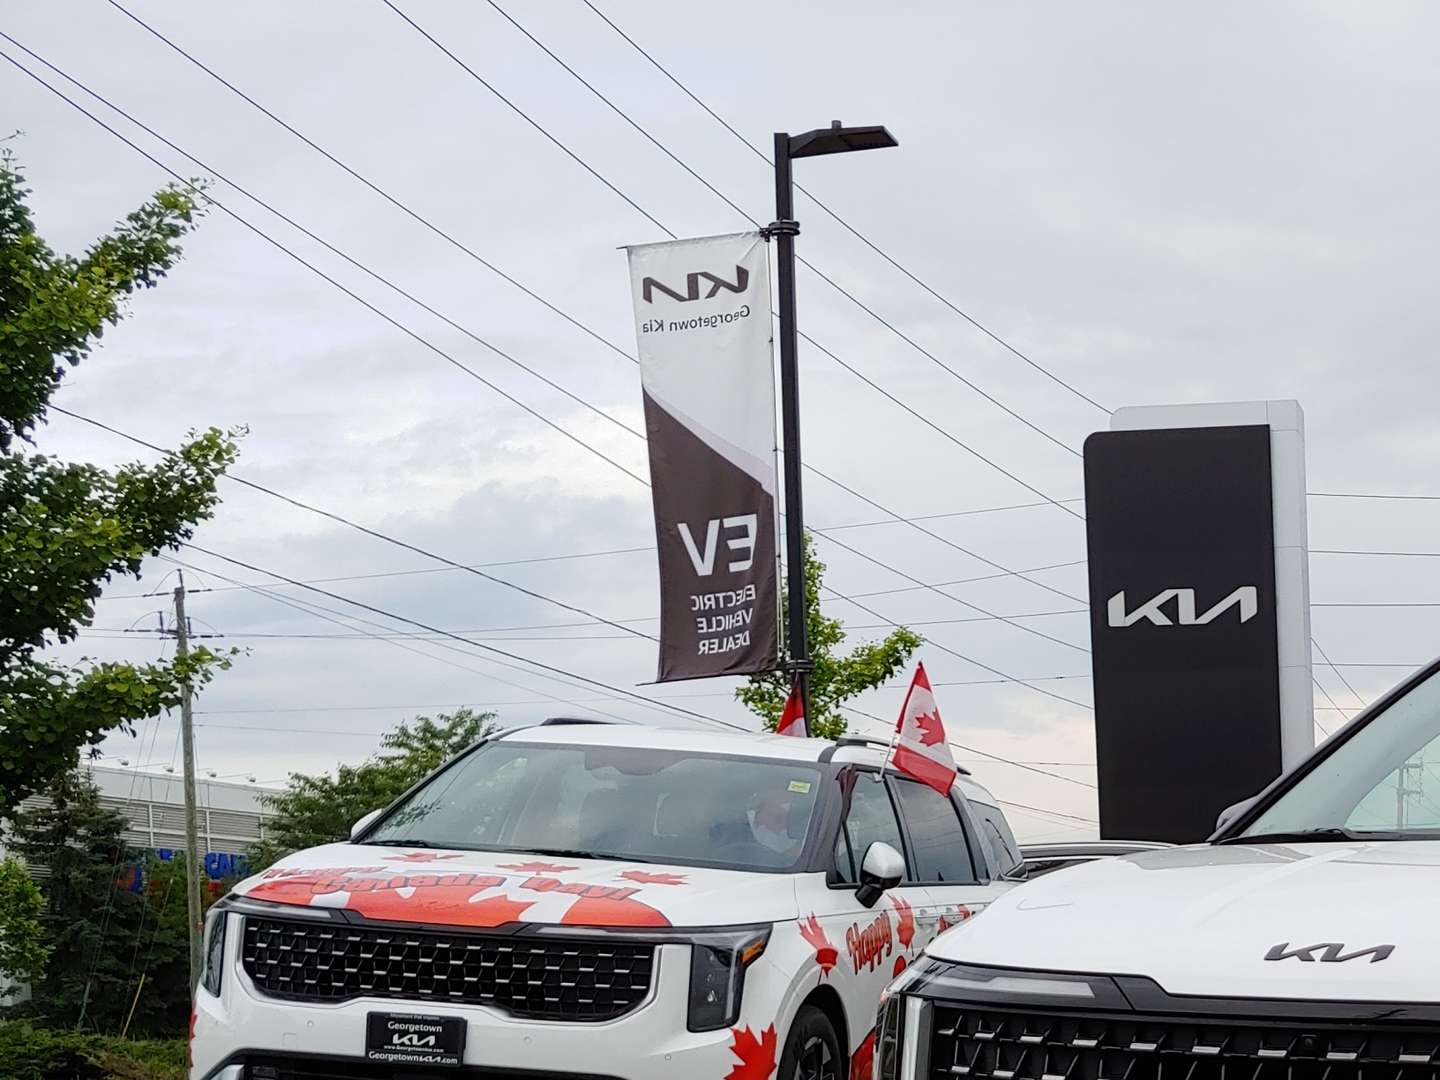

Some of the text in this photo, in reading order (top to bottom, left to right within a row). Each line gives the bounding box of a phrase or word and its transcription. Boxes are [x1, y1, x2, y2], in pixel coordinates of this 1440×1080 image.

[1107, 586, 1258, 627] KIA
[311, 873, 643, 901] Canada Day!
[846, 910, 892, 975] Happy
[1264, 942, 1396, 963] KIA
[387, 1021, 442, 1032] Georgetown
[392, 1033, 436, 1046] KIA
